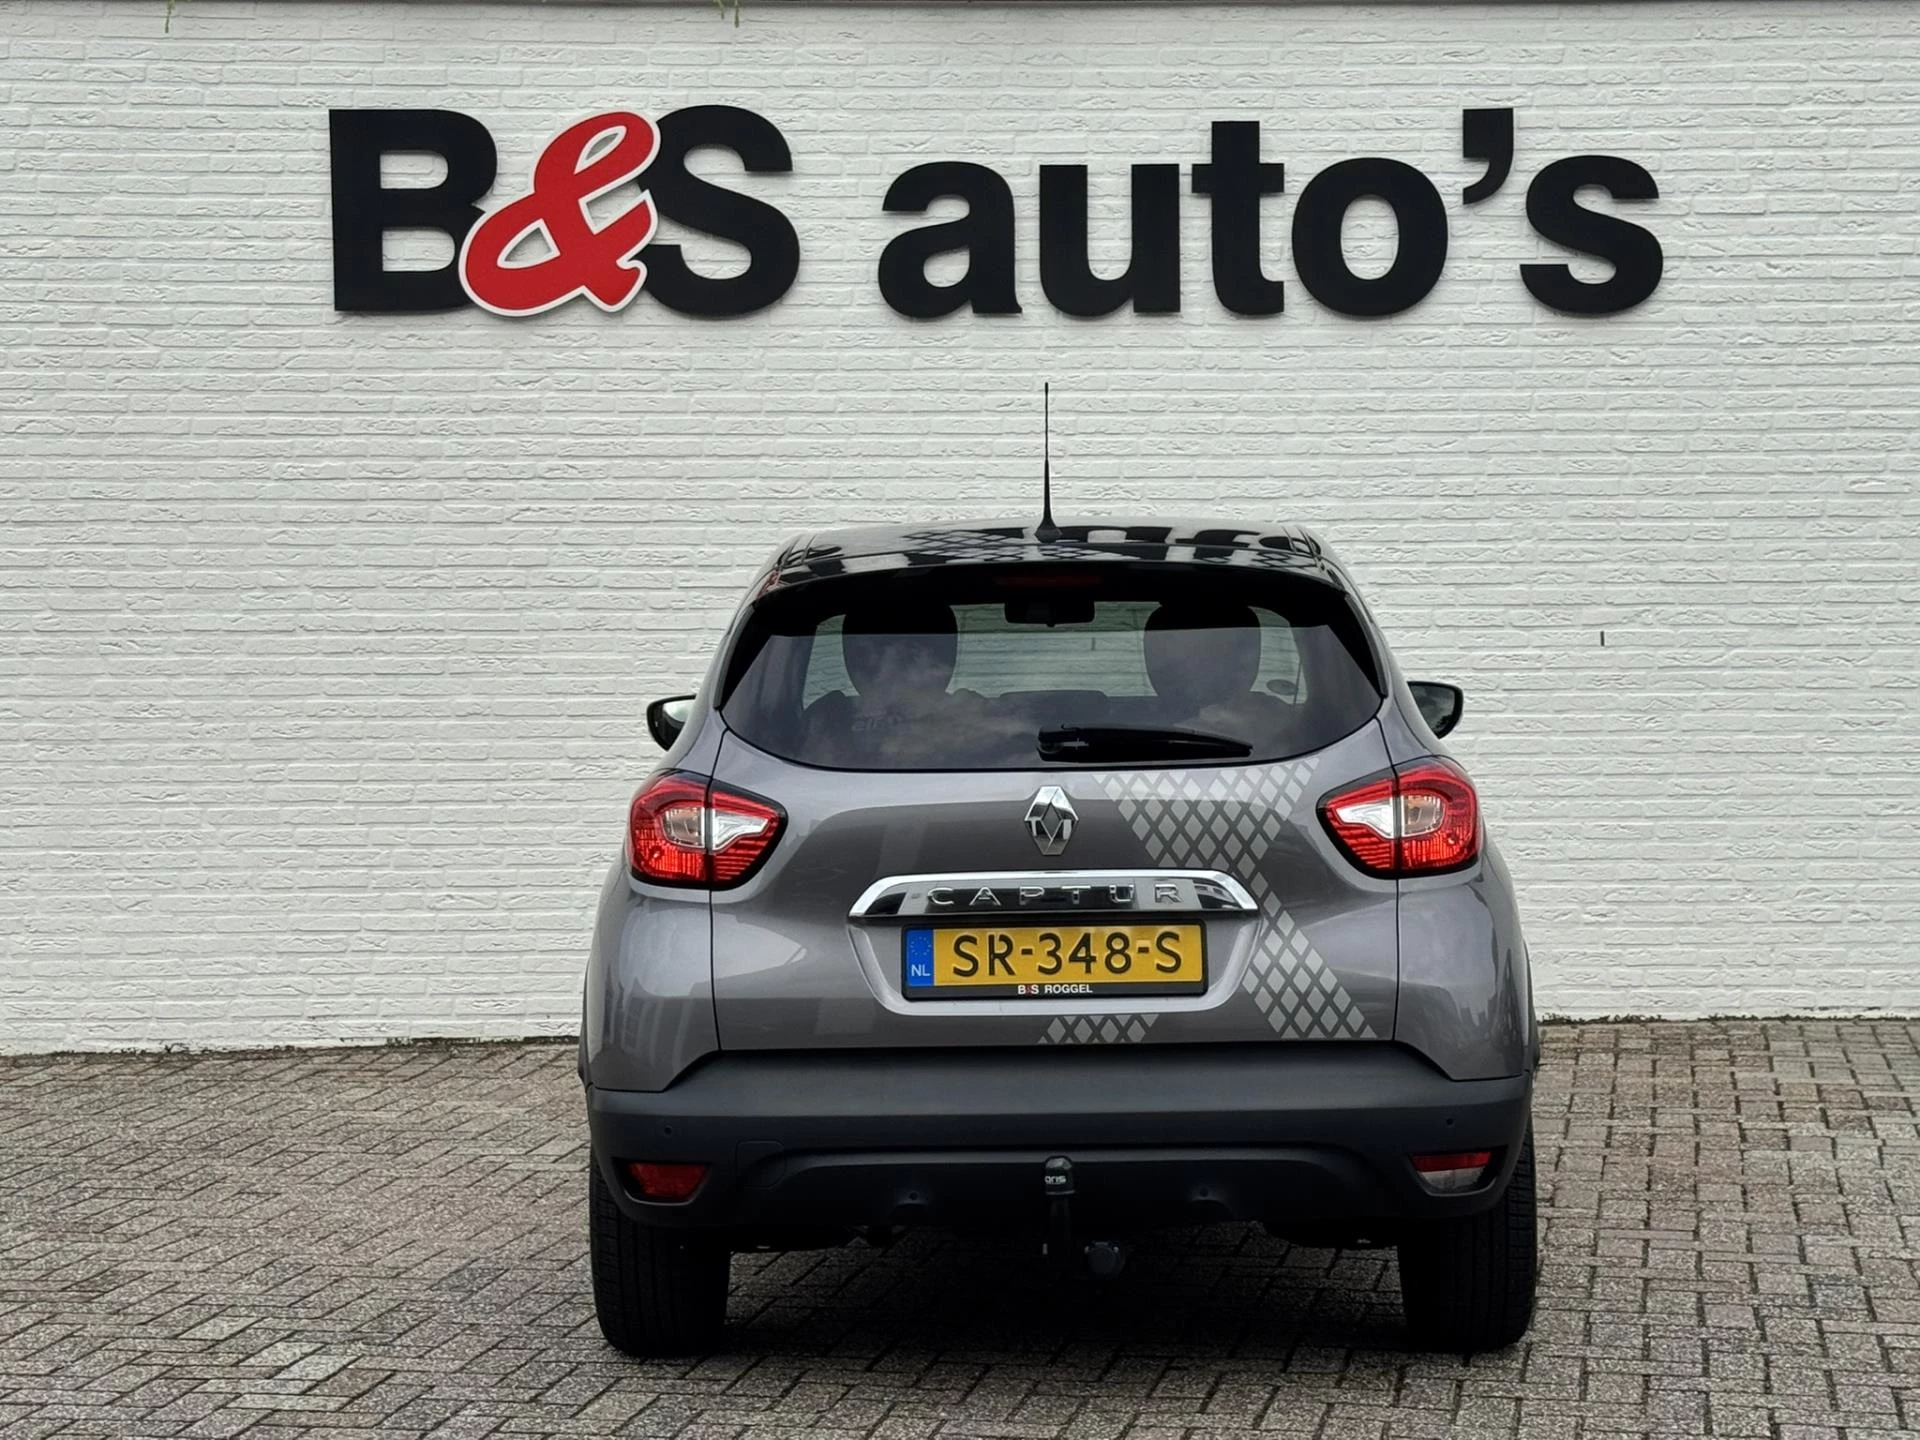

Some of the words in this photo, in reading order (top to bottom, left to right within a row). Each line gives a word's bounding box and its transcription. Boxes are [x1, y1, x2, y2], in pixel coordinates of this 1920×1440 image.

[328, 104, 801, 318] B&S
[927, 884, 1183, 906] CAPTUR
[952, 930, 1183, 978] SR-348-S
[911, 965, 931, 977] NL
[1044, 983, 1094, 994] ROGGEL
